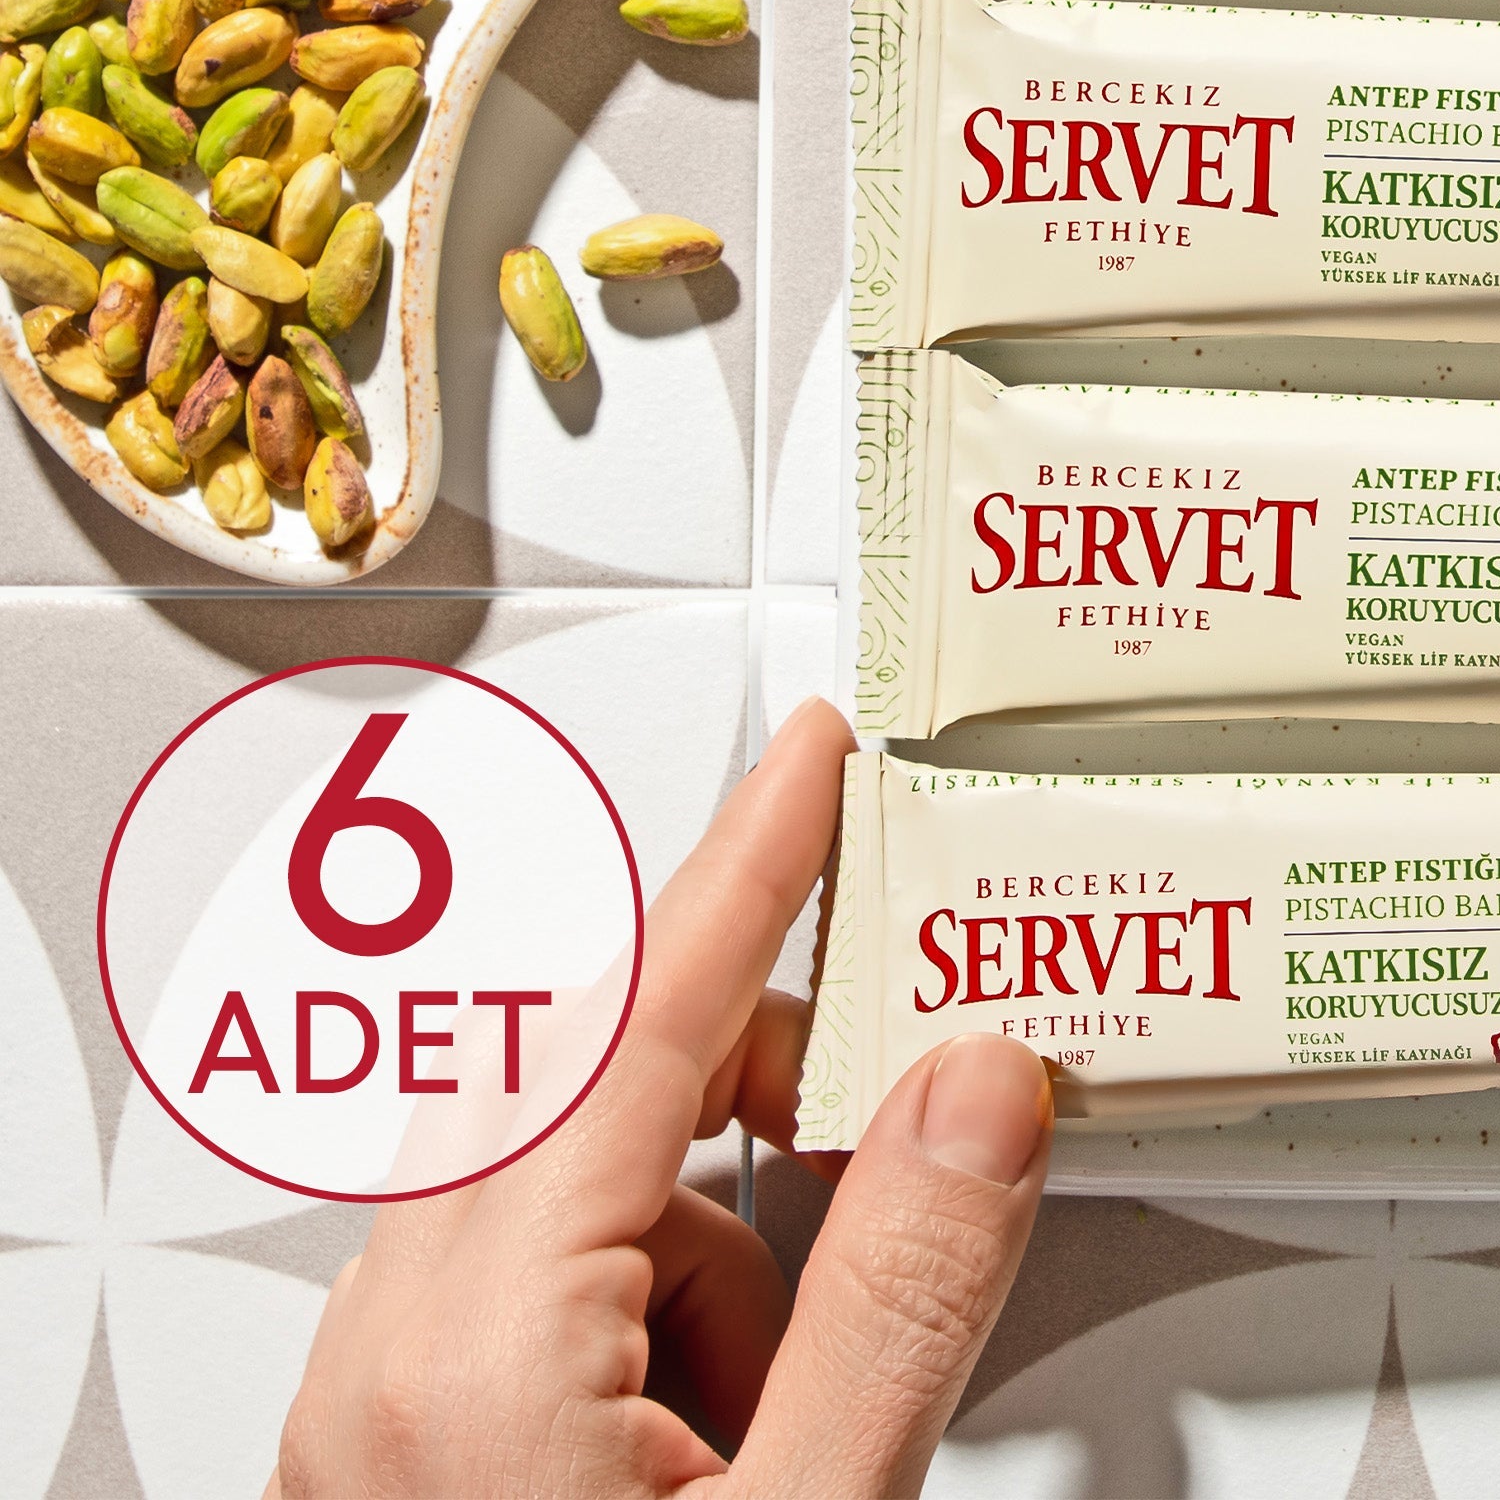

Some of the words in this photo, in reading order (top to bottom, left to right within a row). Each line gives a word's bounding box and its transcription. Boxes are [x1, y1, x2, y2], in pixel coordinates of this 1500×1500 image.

[1025, 80, 1220, 106] BERCEKIZ
[1327, 85, 1428, 109] ANTEP
[1326, 119, 1482, 146] PISTACHIO
[961, 107, 1295, 217] SERVET
[1044, 219, 1191, 247] FETHİYE
[1099, 255, 1135, 271] 1987
[1321, 251, 1377, 264] VEGAN
[1321, 267, 1387, 284] YÜKSEK
[1393, 269, 1419, 284] LİF
[1425, 272, 1500, 287] KAYNAĞI
[1037, 465, 1241, 490] BERCEKIZ
[1352, 468, 1457, 490] ANTEP
[971, 492, 1318, 600] SERVET
[1057, 603, 1210, 631] FETHİYE
[1114, 640, 1152, 656] 1987
[1345, 633, 1404, 647] VEGAN
[1345, 650, 1414, 666] YÜKSEK
[1421, 651, 1448, 666] LİF
[1284, 861, 1386, 885] ANTEP
[976, 872, 1175, 899] BERCEKIZ
[1285, 895, 1444, 921] PISTACHIO
[914, 896, 1252, 1013] SERVET
[1284, 947, 1488, 984] KATKISIZ
[1001, 1010, 1153, 1039] FETHİYE
[1287, 1032, 1344, 1045] VEGAN
[1056, 1050, 1095, 1067] 1987
[1287, 1049, 1356, 1064] YÜKSEK
[1362, 1048, 1389, 1063] LİF
[1395, 1045, 1473, 1061] KAYNAĞI
